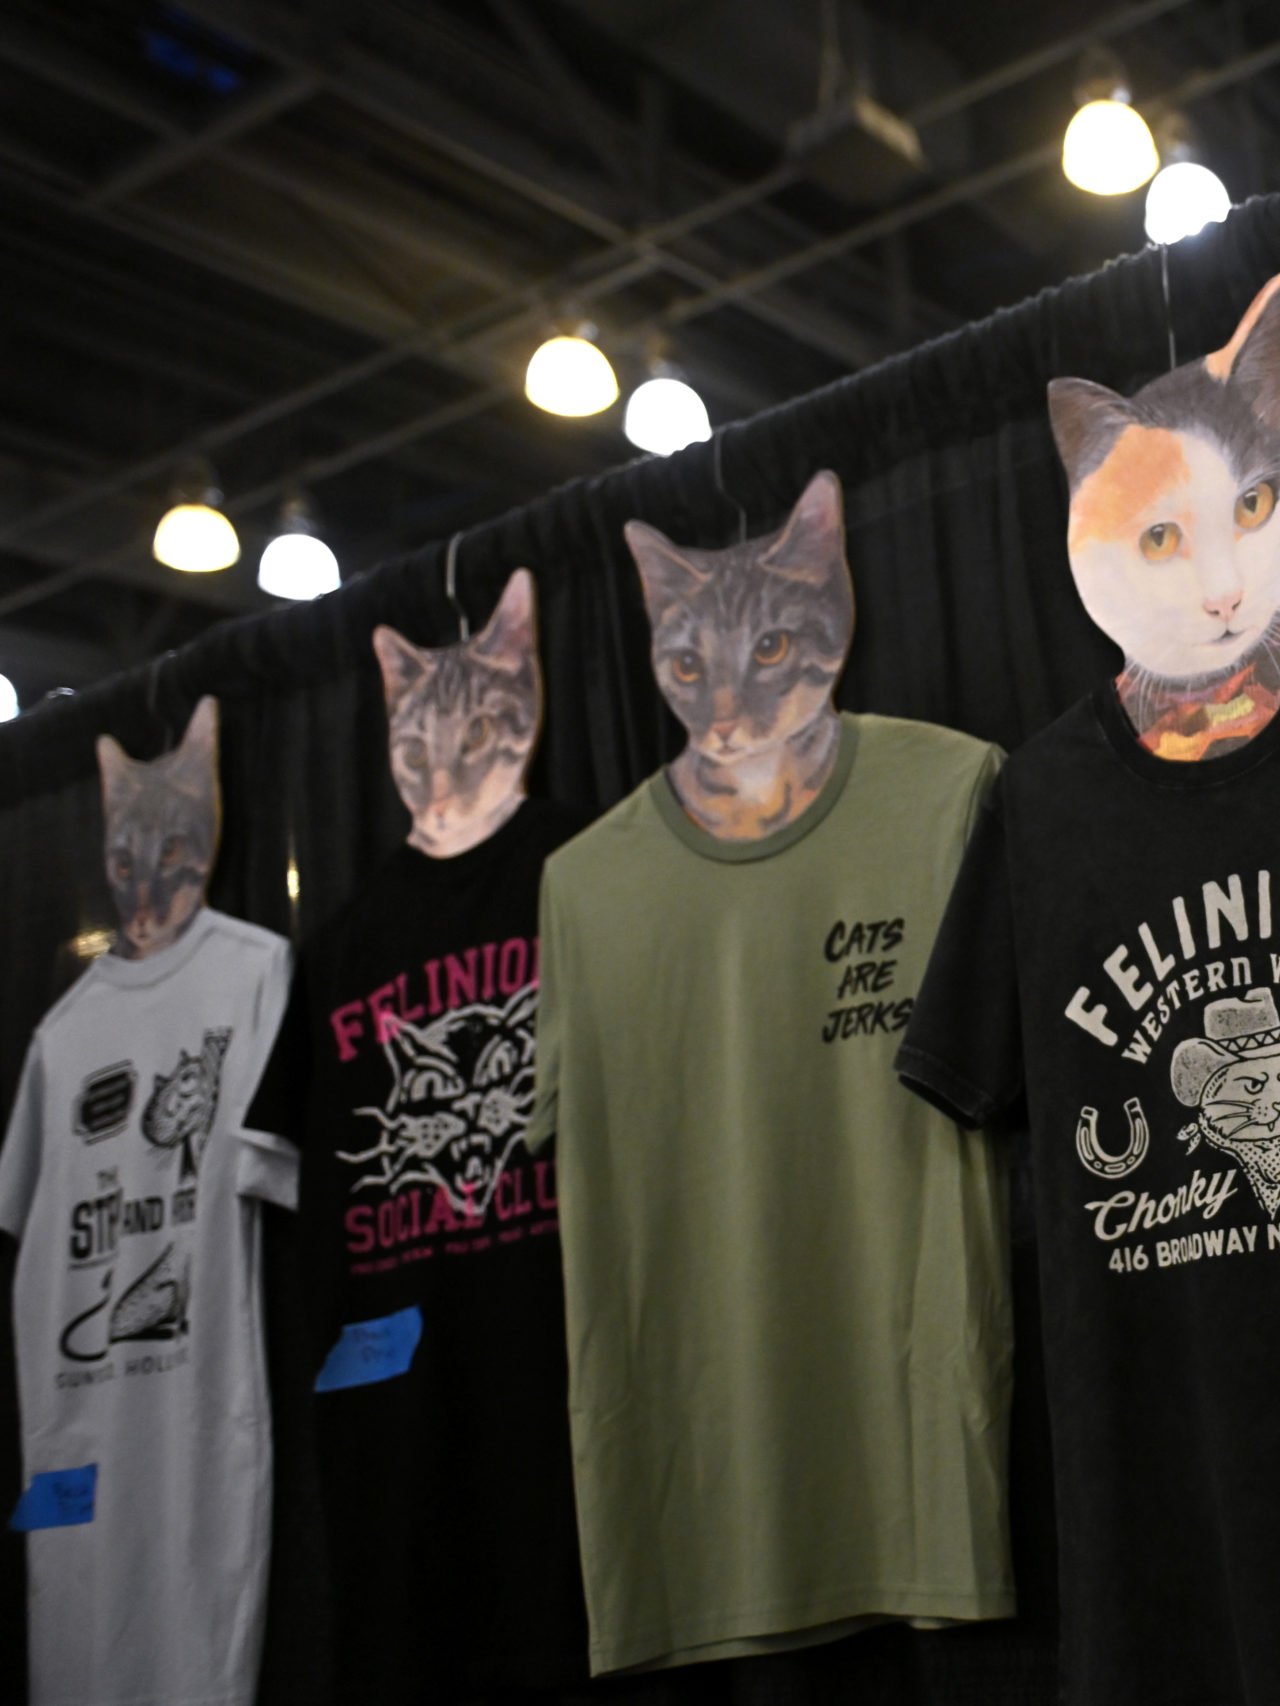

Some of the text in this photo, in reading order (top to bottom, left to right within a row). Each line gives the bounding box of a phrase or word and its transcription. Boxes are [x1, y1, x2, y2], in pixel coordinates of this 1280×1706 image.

[824, 917, 905, 963] CATS
[330, 937, 540, 1062] FELINIO
[837, 959, 898, 1000] ARE
[821, 997, 915, 1044] JERKS
[1121, 956, 1252, 1064] WESTERN
[344, 1181, 485, 1253] SOCIAL
[495, 1161, 560, 1221] CLU
[1084, 1169, 1239, 1241] Chonky
[1108, 1246, 1149, 1273] 416
[1156, 1225, 1258, 1267] BROADWAY
